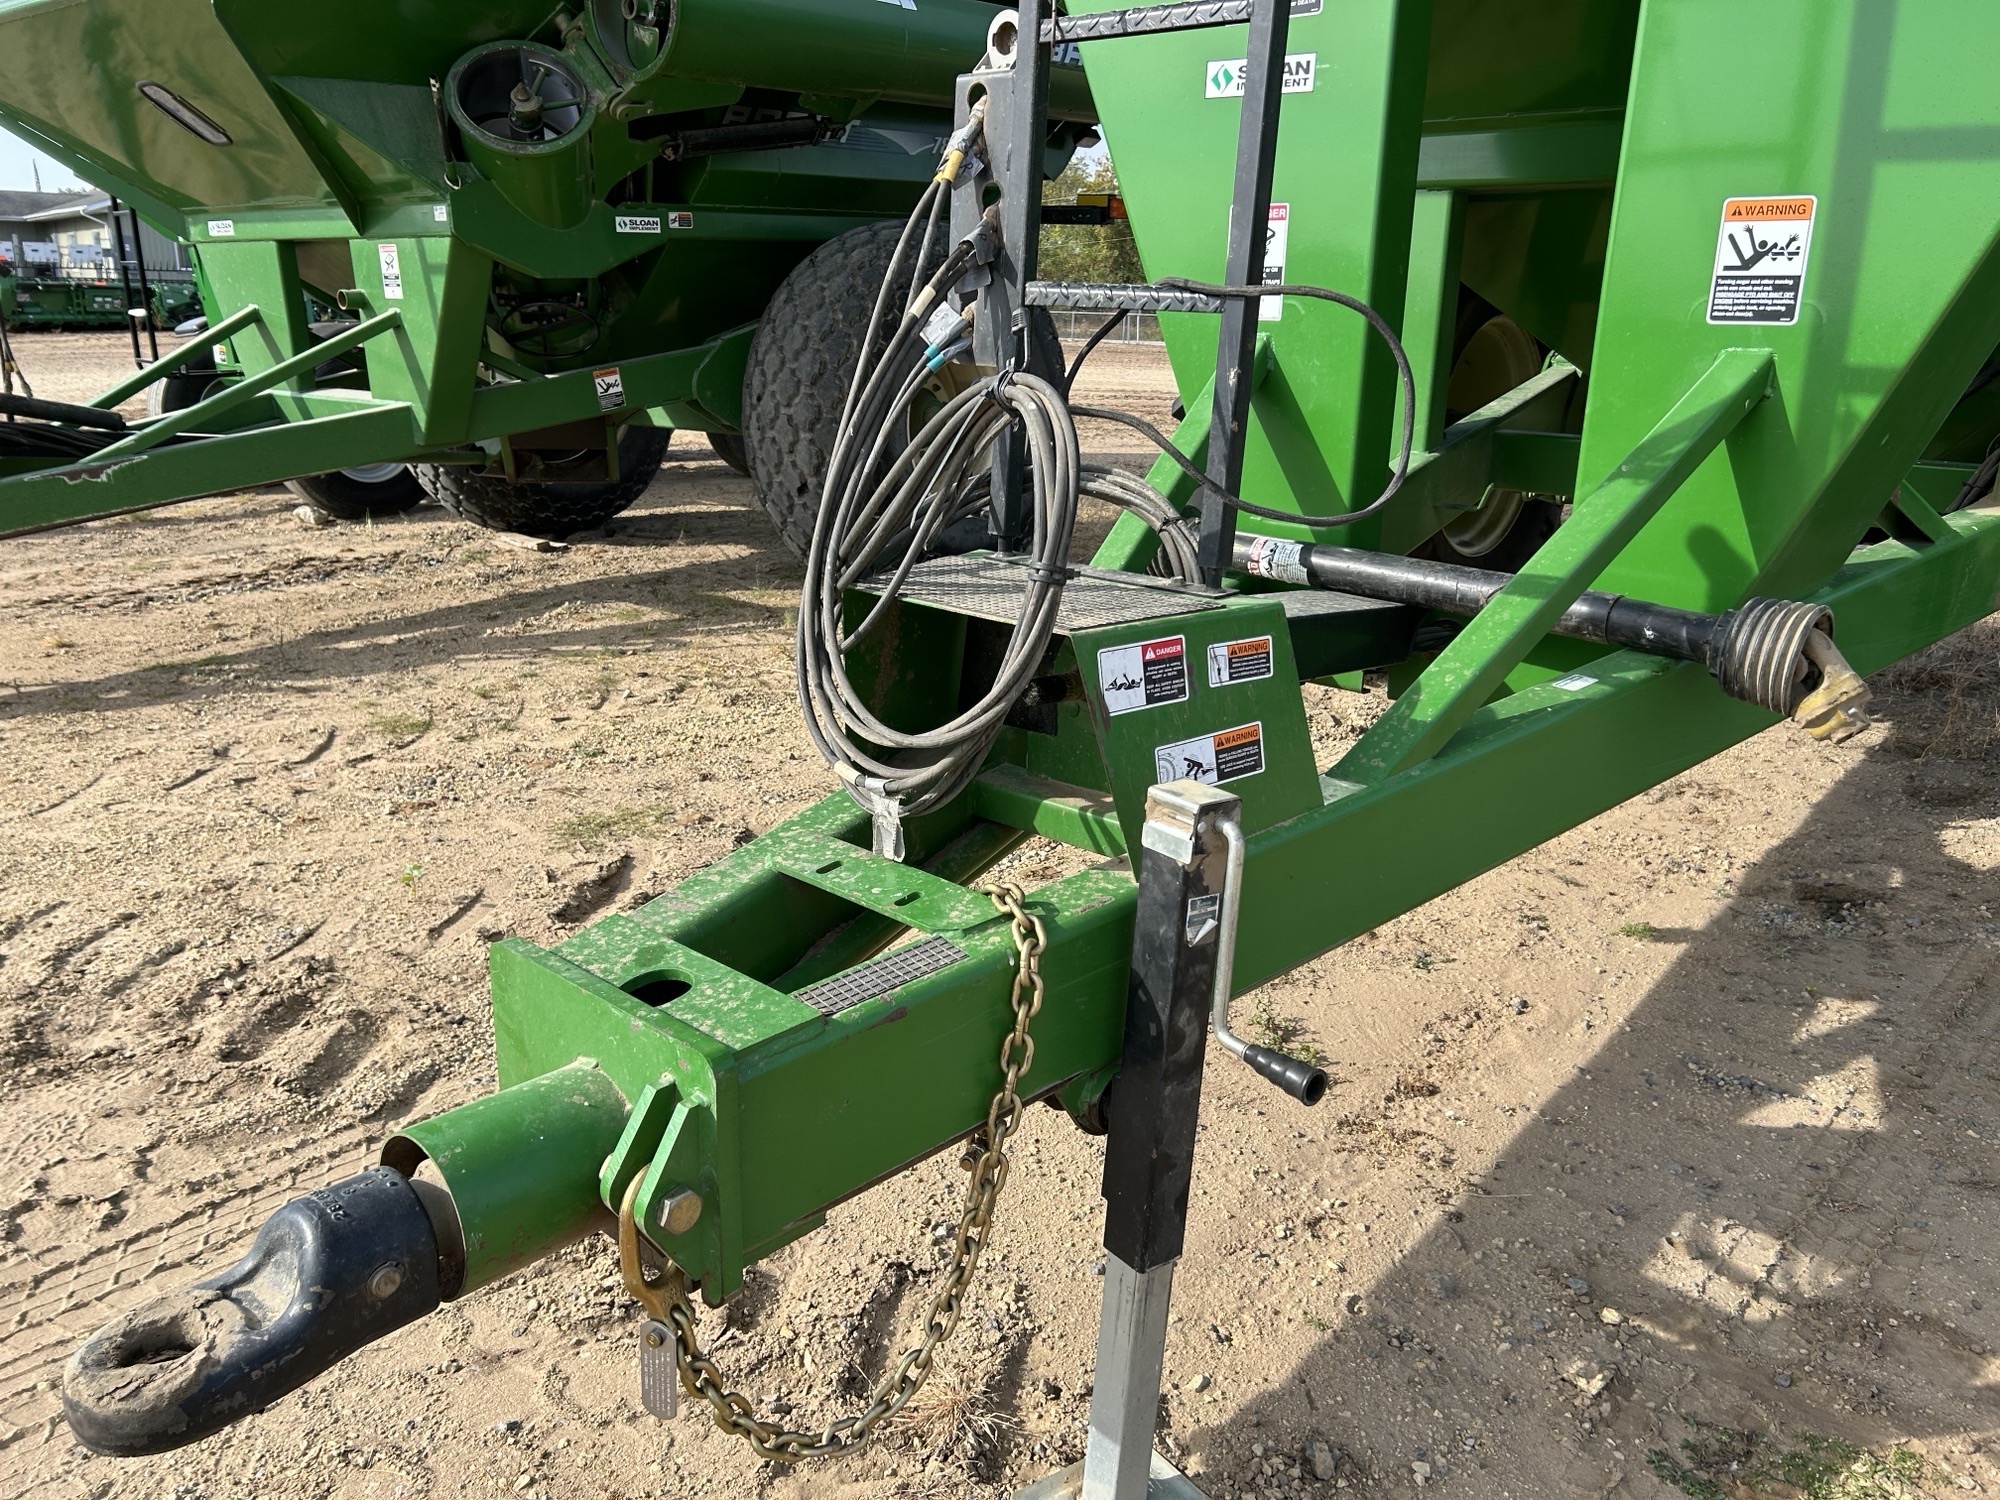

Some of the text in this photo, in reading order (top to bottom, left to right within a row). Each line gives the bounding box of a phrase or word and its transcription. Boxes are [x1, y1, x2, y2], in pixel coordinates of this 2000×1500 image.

[1237, 60, 1311, 80] SAN
[1745, 204, 1807, 216] WARNING
[628, 219, 659, 227] SLOAN
[1156, 645, 1181, 656] DANGER
[1237, 641, 1268, 655] WARNING
[1224, 729, 1258, 745] WARNING
